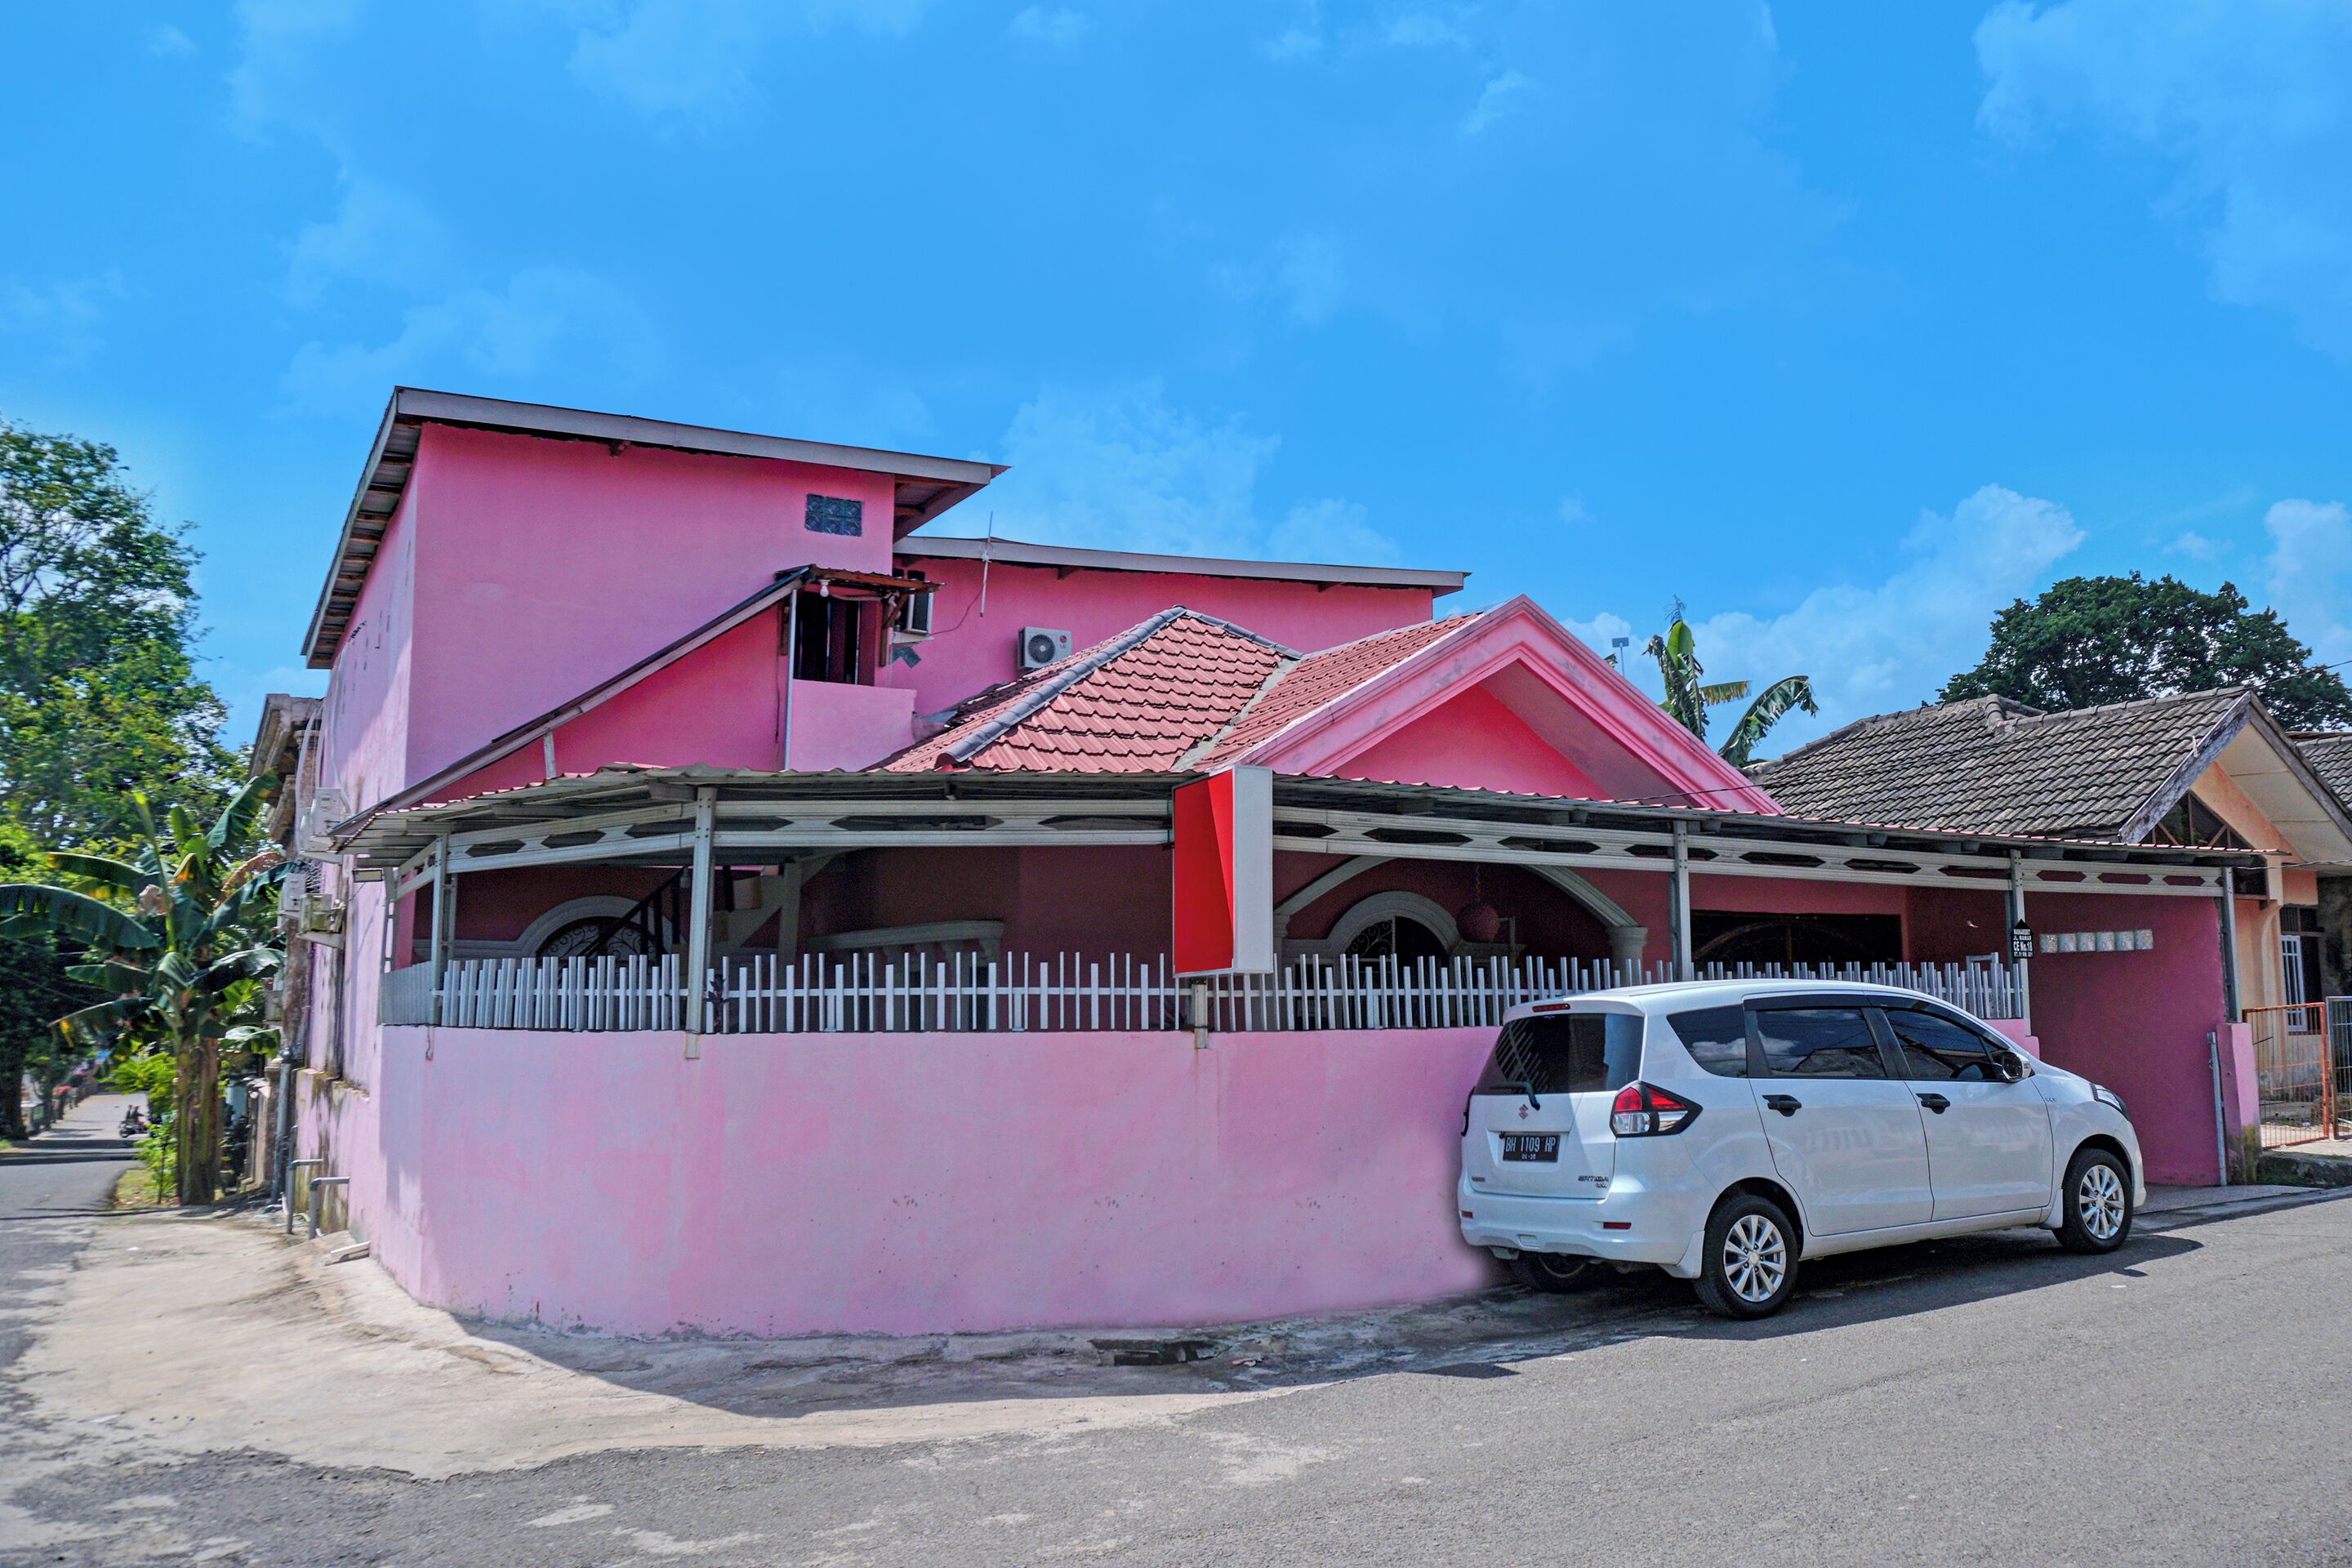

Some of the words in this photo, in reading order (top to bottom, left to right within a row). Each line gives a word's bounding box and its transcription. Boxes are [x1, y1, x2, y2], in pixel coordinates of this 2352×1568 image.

[1505, 1136, 1517, 1152] BH
[1521, 1136, 1540, 1152] 1109
[1544, 1136, 1557, 1152] HP
